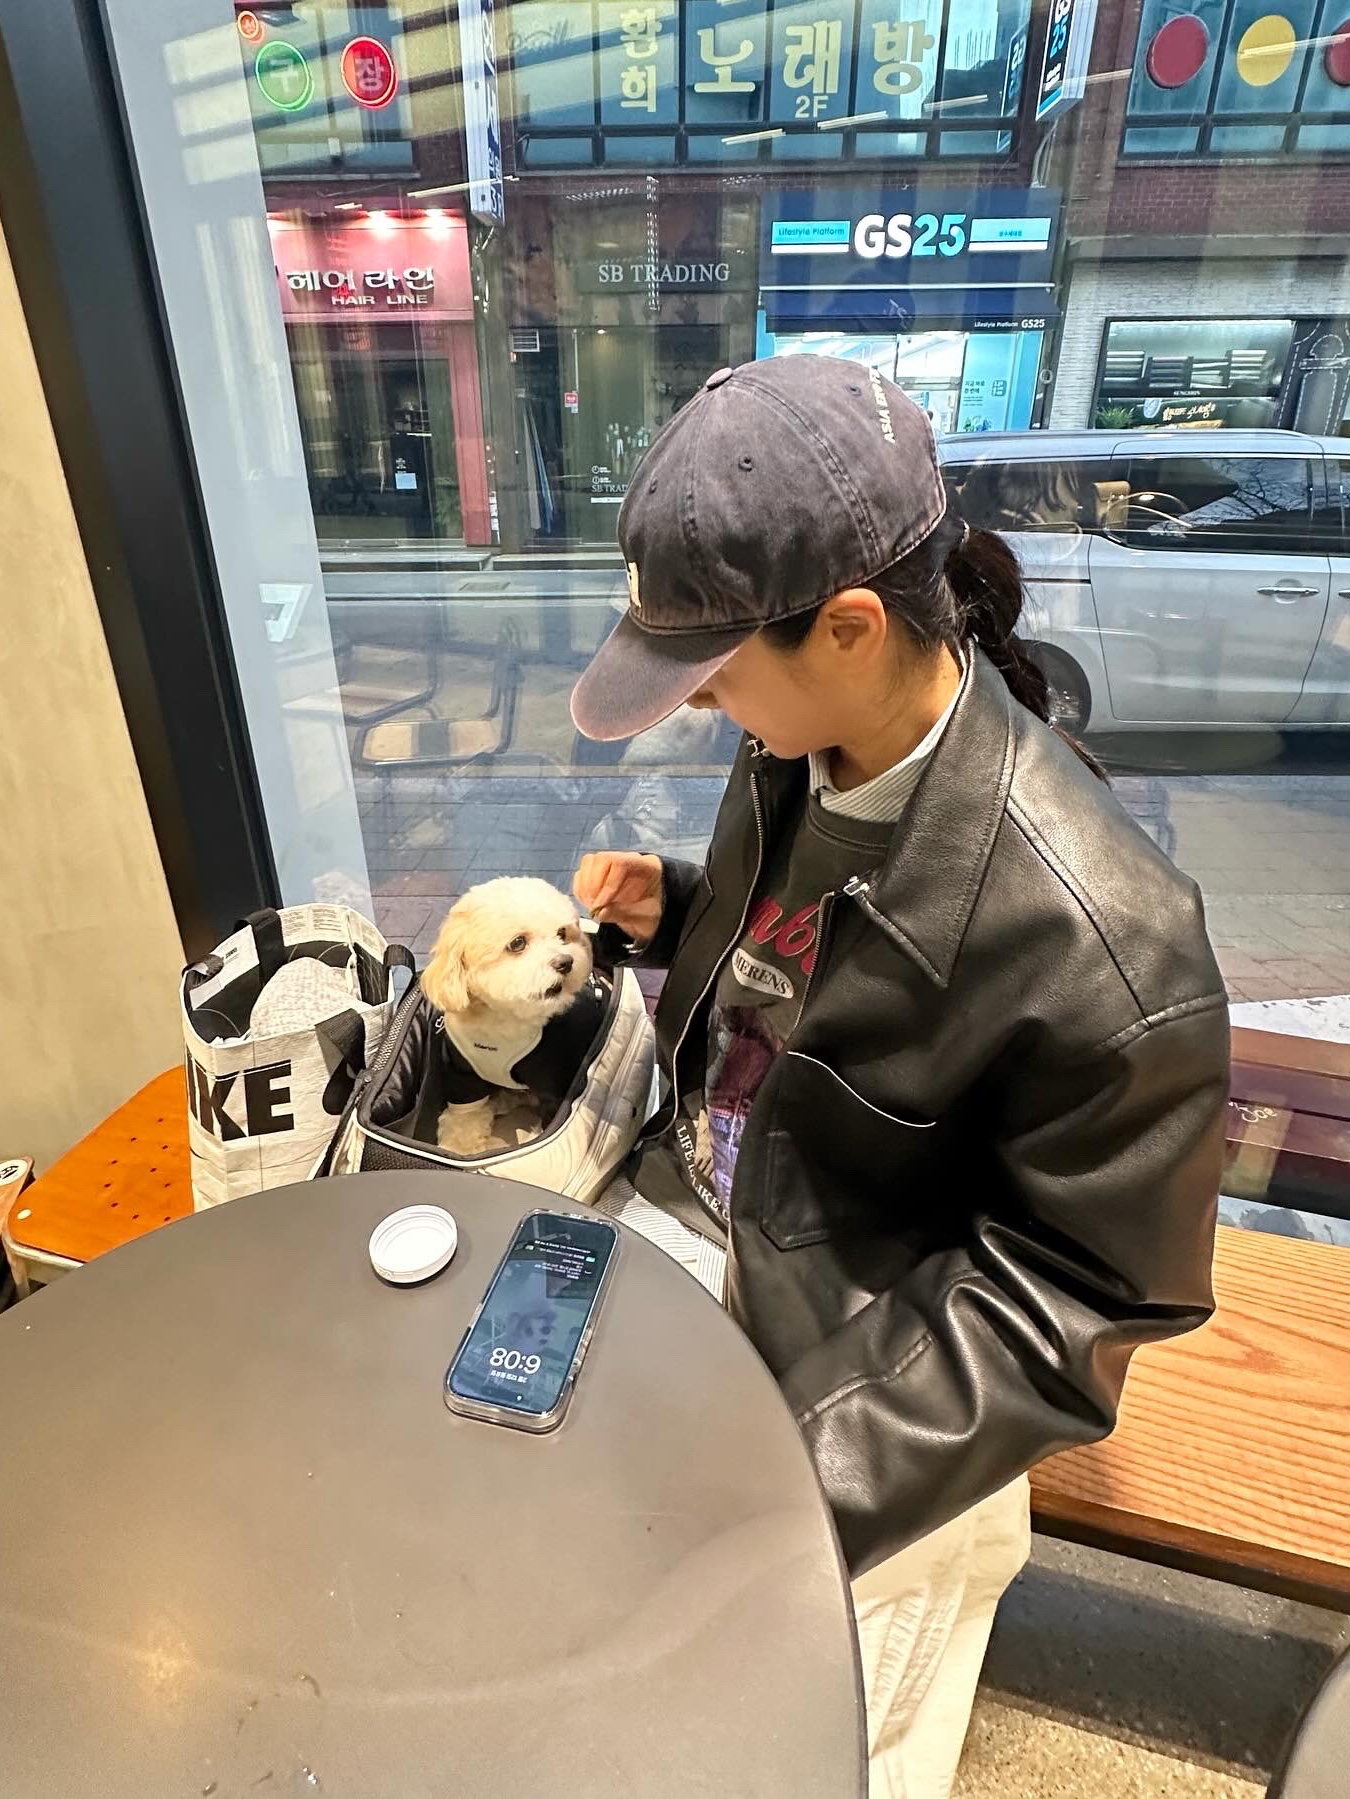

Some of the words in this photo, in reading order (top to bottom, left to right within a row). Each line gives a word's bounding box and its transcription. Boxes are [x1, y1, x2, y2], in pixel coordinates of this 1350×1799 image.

[694, 20, 936, 96] 노래방
[795, 95, 829, 118] 2F
[779, 228, 810, 236] Lifestyle
[812, 227, 845, 235] Platform
[854, 213, 967, 258] GS25
[285, 269, 356, 292] 헤어
[363, 266, 434, 291] 라인
[598, 264, 624, 282] SB
[630, 263, 731, 282] TRADING
[331, 295, 375, 305] HAIR
[386, 294, 428, 305] LINE
[1021, 319, 1046, 328] GS25
[677, 1124, 696, 1161] LIFE
